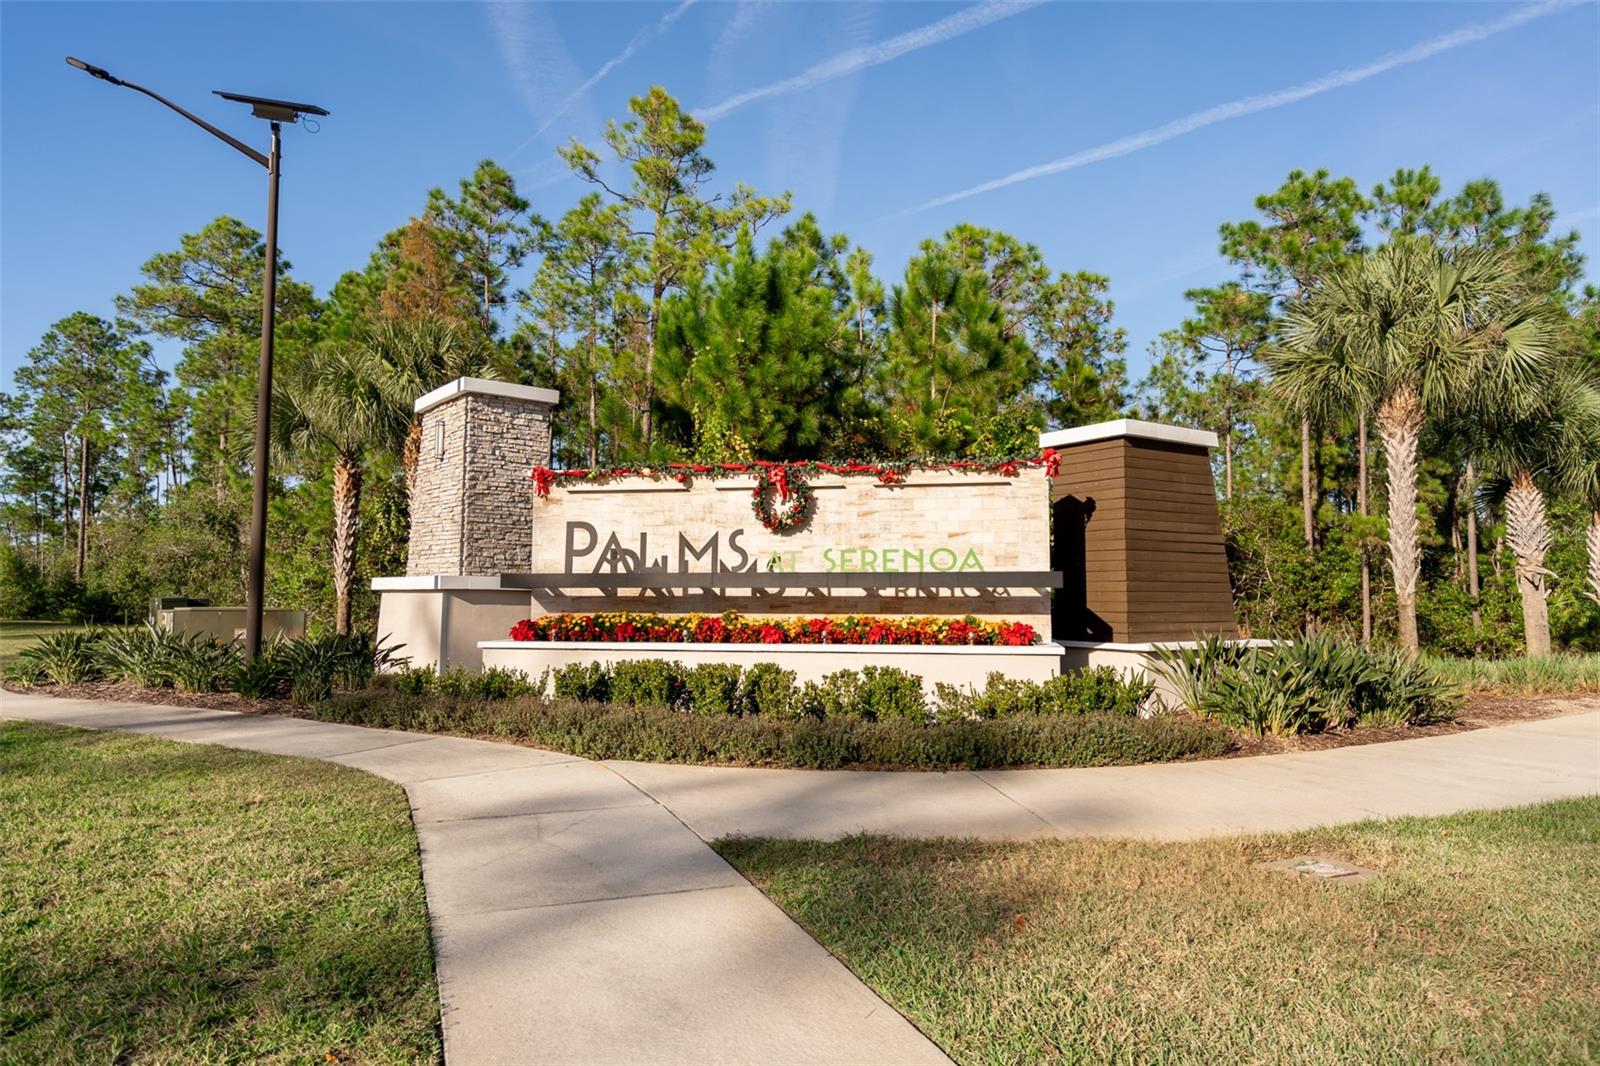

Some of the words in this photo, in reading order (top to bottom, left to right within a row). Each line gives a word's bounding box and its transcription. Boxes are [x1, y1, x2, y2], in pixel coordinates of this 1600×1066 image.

[564, 520, 749, 574] PALMS
[766, 550, 803, 573] AT
[823, 547, 985, 573] SERENOA
